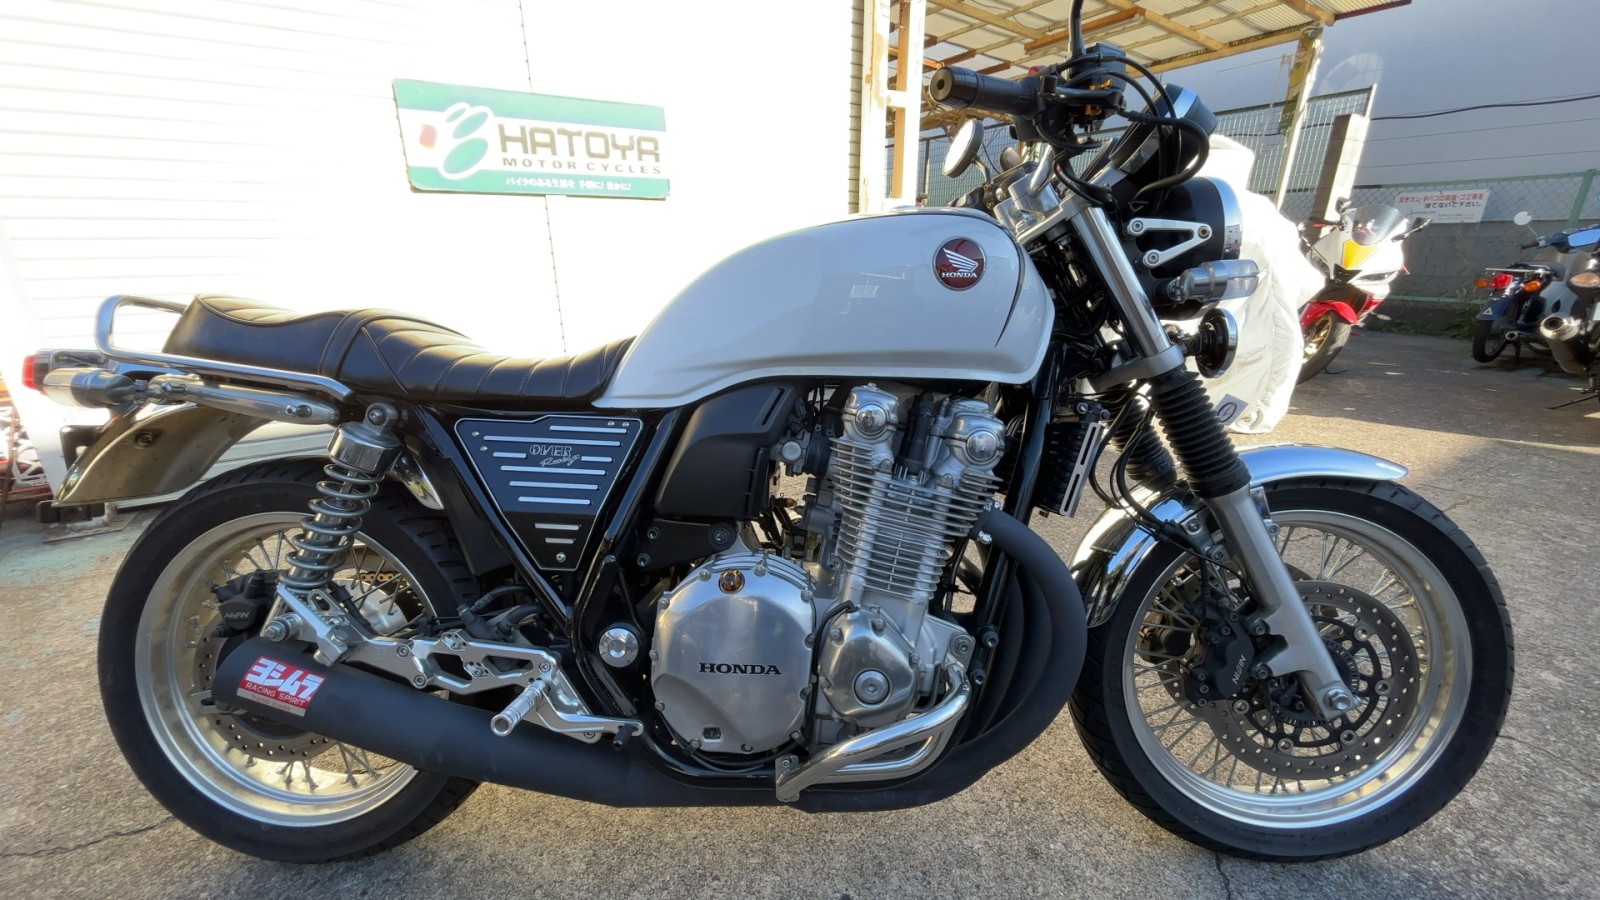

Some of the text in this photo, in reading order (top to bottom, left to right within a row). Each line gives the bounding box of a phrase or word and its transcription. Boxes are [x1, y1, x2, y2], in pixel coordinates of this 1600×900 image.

[498, 123, 661, 163] HATOYA
[502, 157, 661, 175] MOTOR CYCLES
[529, 444, 573, 457] OVER
[540, 454, 580, 467] Racing
[698, 662, 783, 675] HONDA
[246, 658, 325, 700] ヨシムラ
[245, 682, 307, 707] RACING SPIRIT
